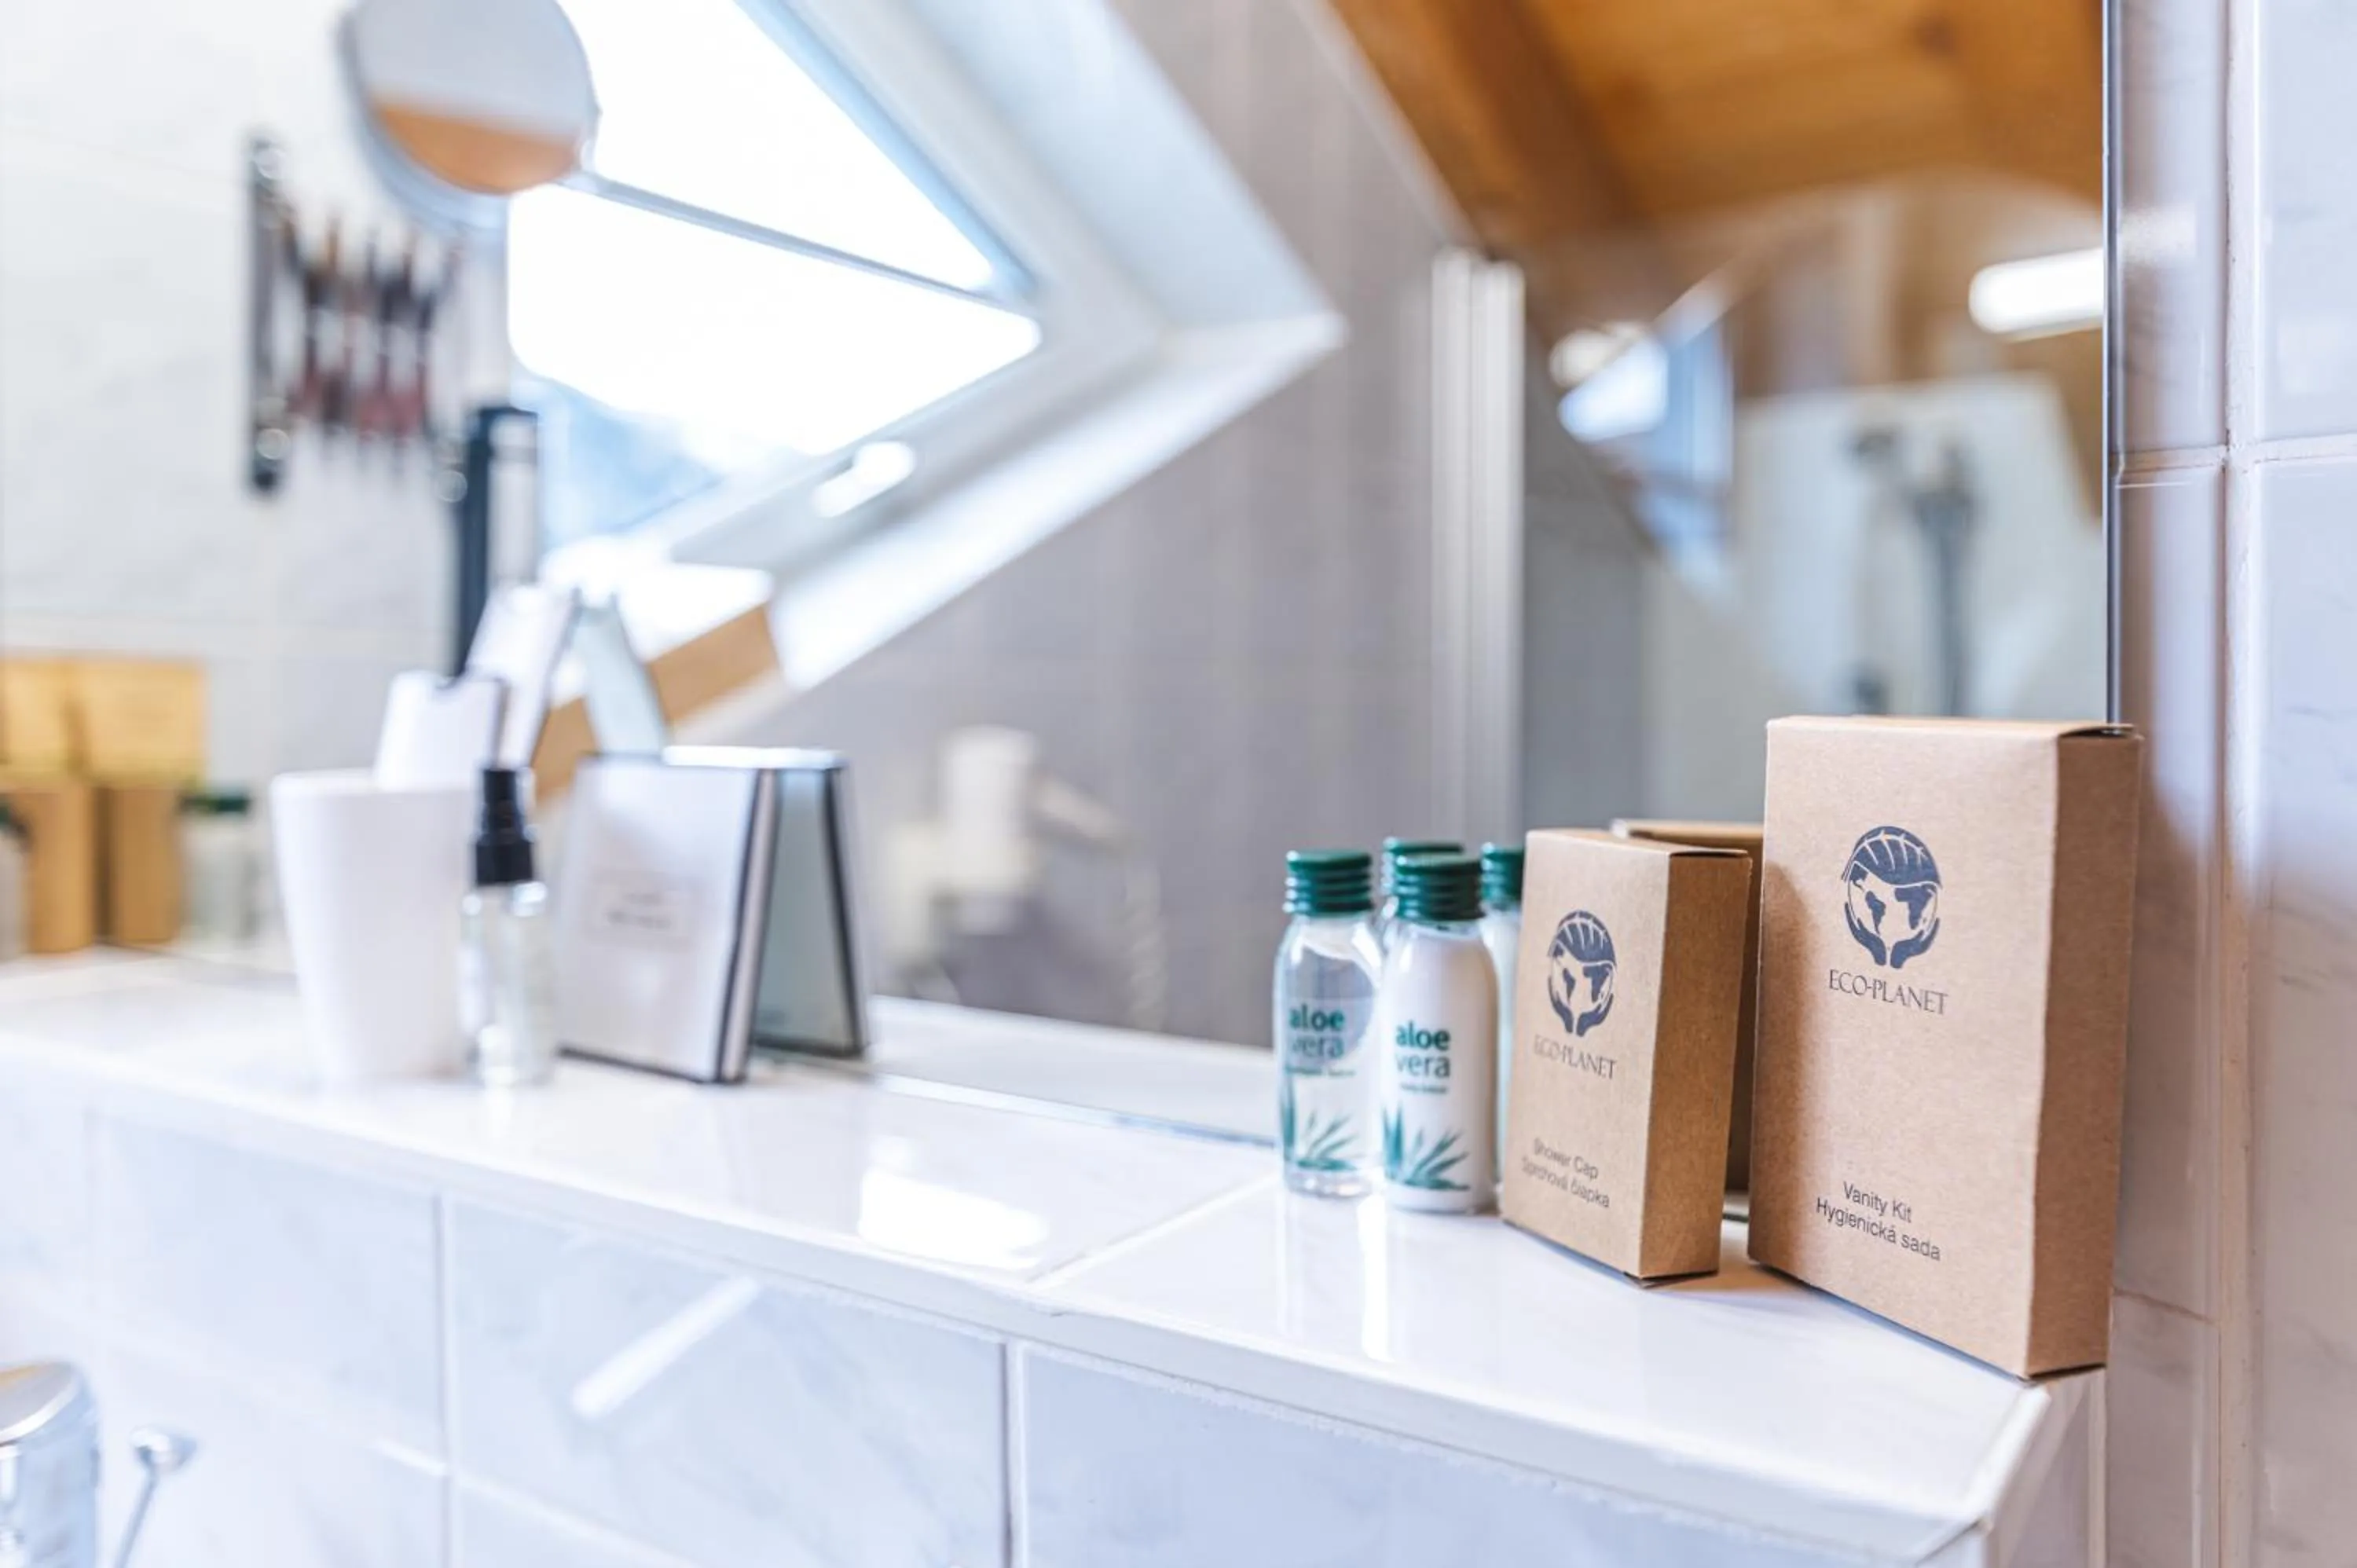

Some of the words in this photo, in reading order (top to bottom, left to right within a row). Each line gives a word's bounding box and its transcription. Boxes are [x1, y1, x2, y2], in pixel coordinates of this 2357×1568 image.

[1829, 969, 1948, 1015] ECO-PLANET
[1289, 1003, 1345, 1031] aloe
[1292, 1036, 1344, 1060] vera
[1395, 1020, 1450, 1051] aloe
[1395, 1054, 1450, 1079] vera
[1534, 1035, 1617, 1079] ECO-PLANET
[1574, 1156, 1599, 1181] Cap
[1843, 1181, 1887, 1216] Vanity
[1892, 1198, 1912, 1223] Kit
[1816, 1197, 1896, 1244] Hygienická
[1901, 1233, 1941, 1261] sada
